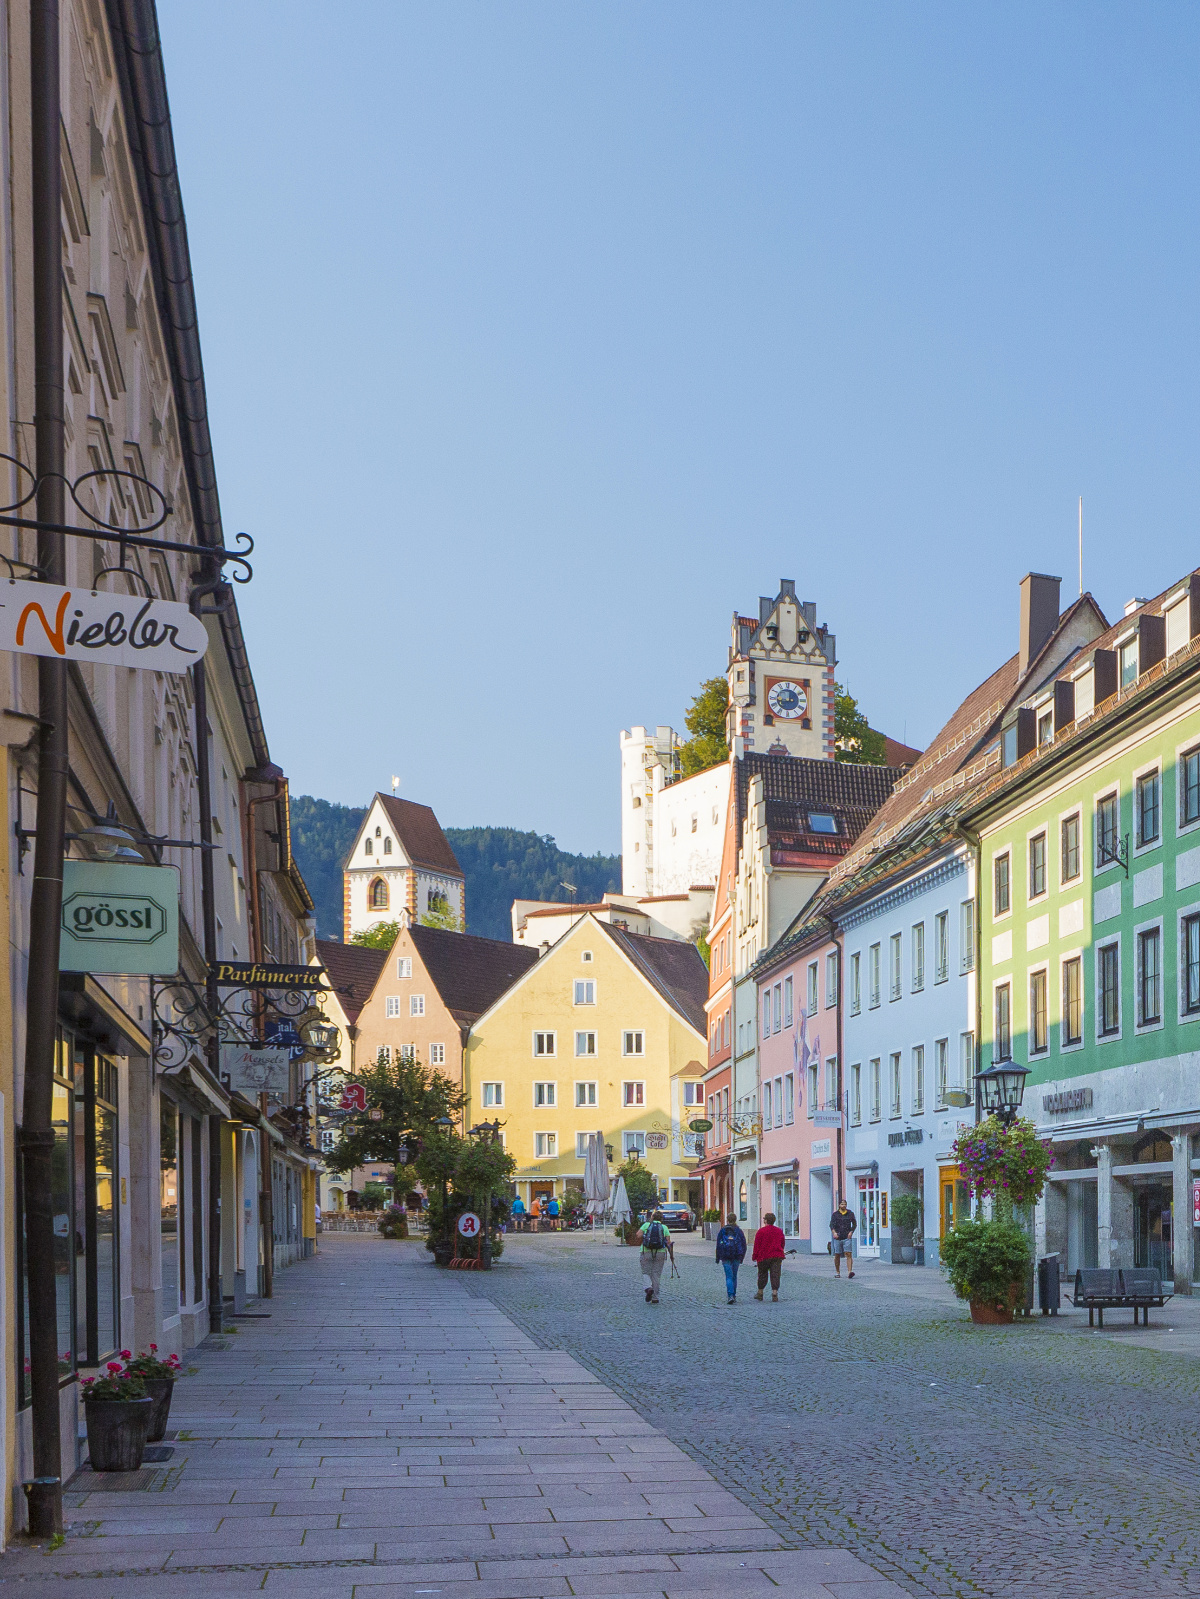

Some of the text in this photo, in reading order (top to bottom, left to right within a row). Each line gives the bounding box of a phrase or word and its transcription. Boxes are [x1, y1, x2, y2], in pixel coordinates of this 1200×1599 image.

[16, 591, 198, 656] Niebler
[73, 903, 152, 933] gössl
[216, 964, 318, 985] Parfümerie
[277, 1021, 295, 1032] ital.
